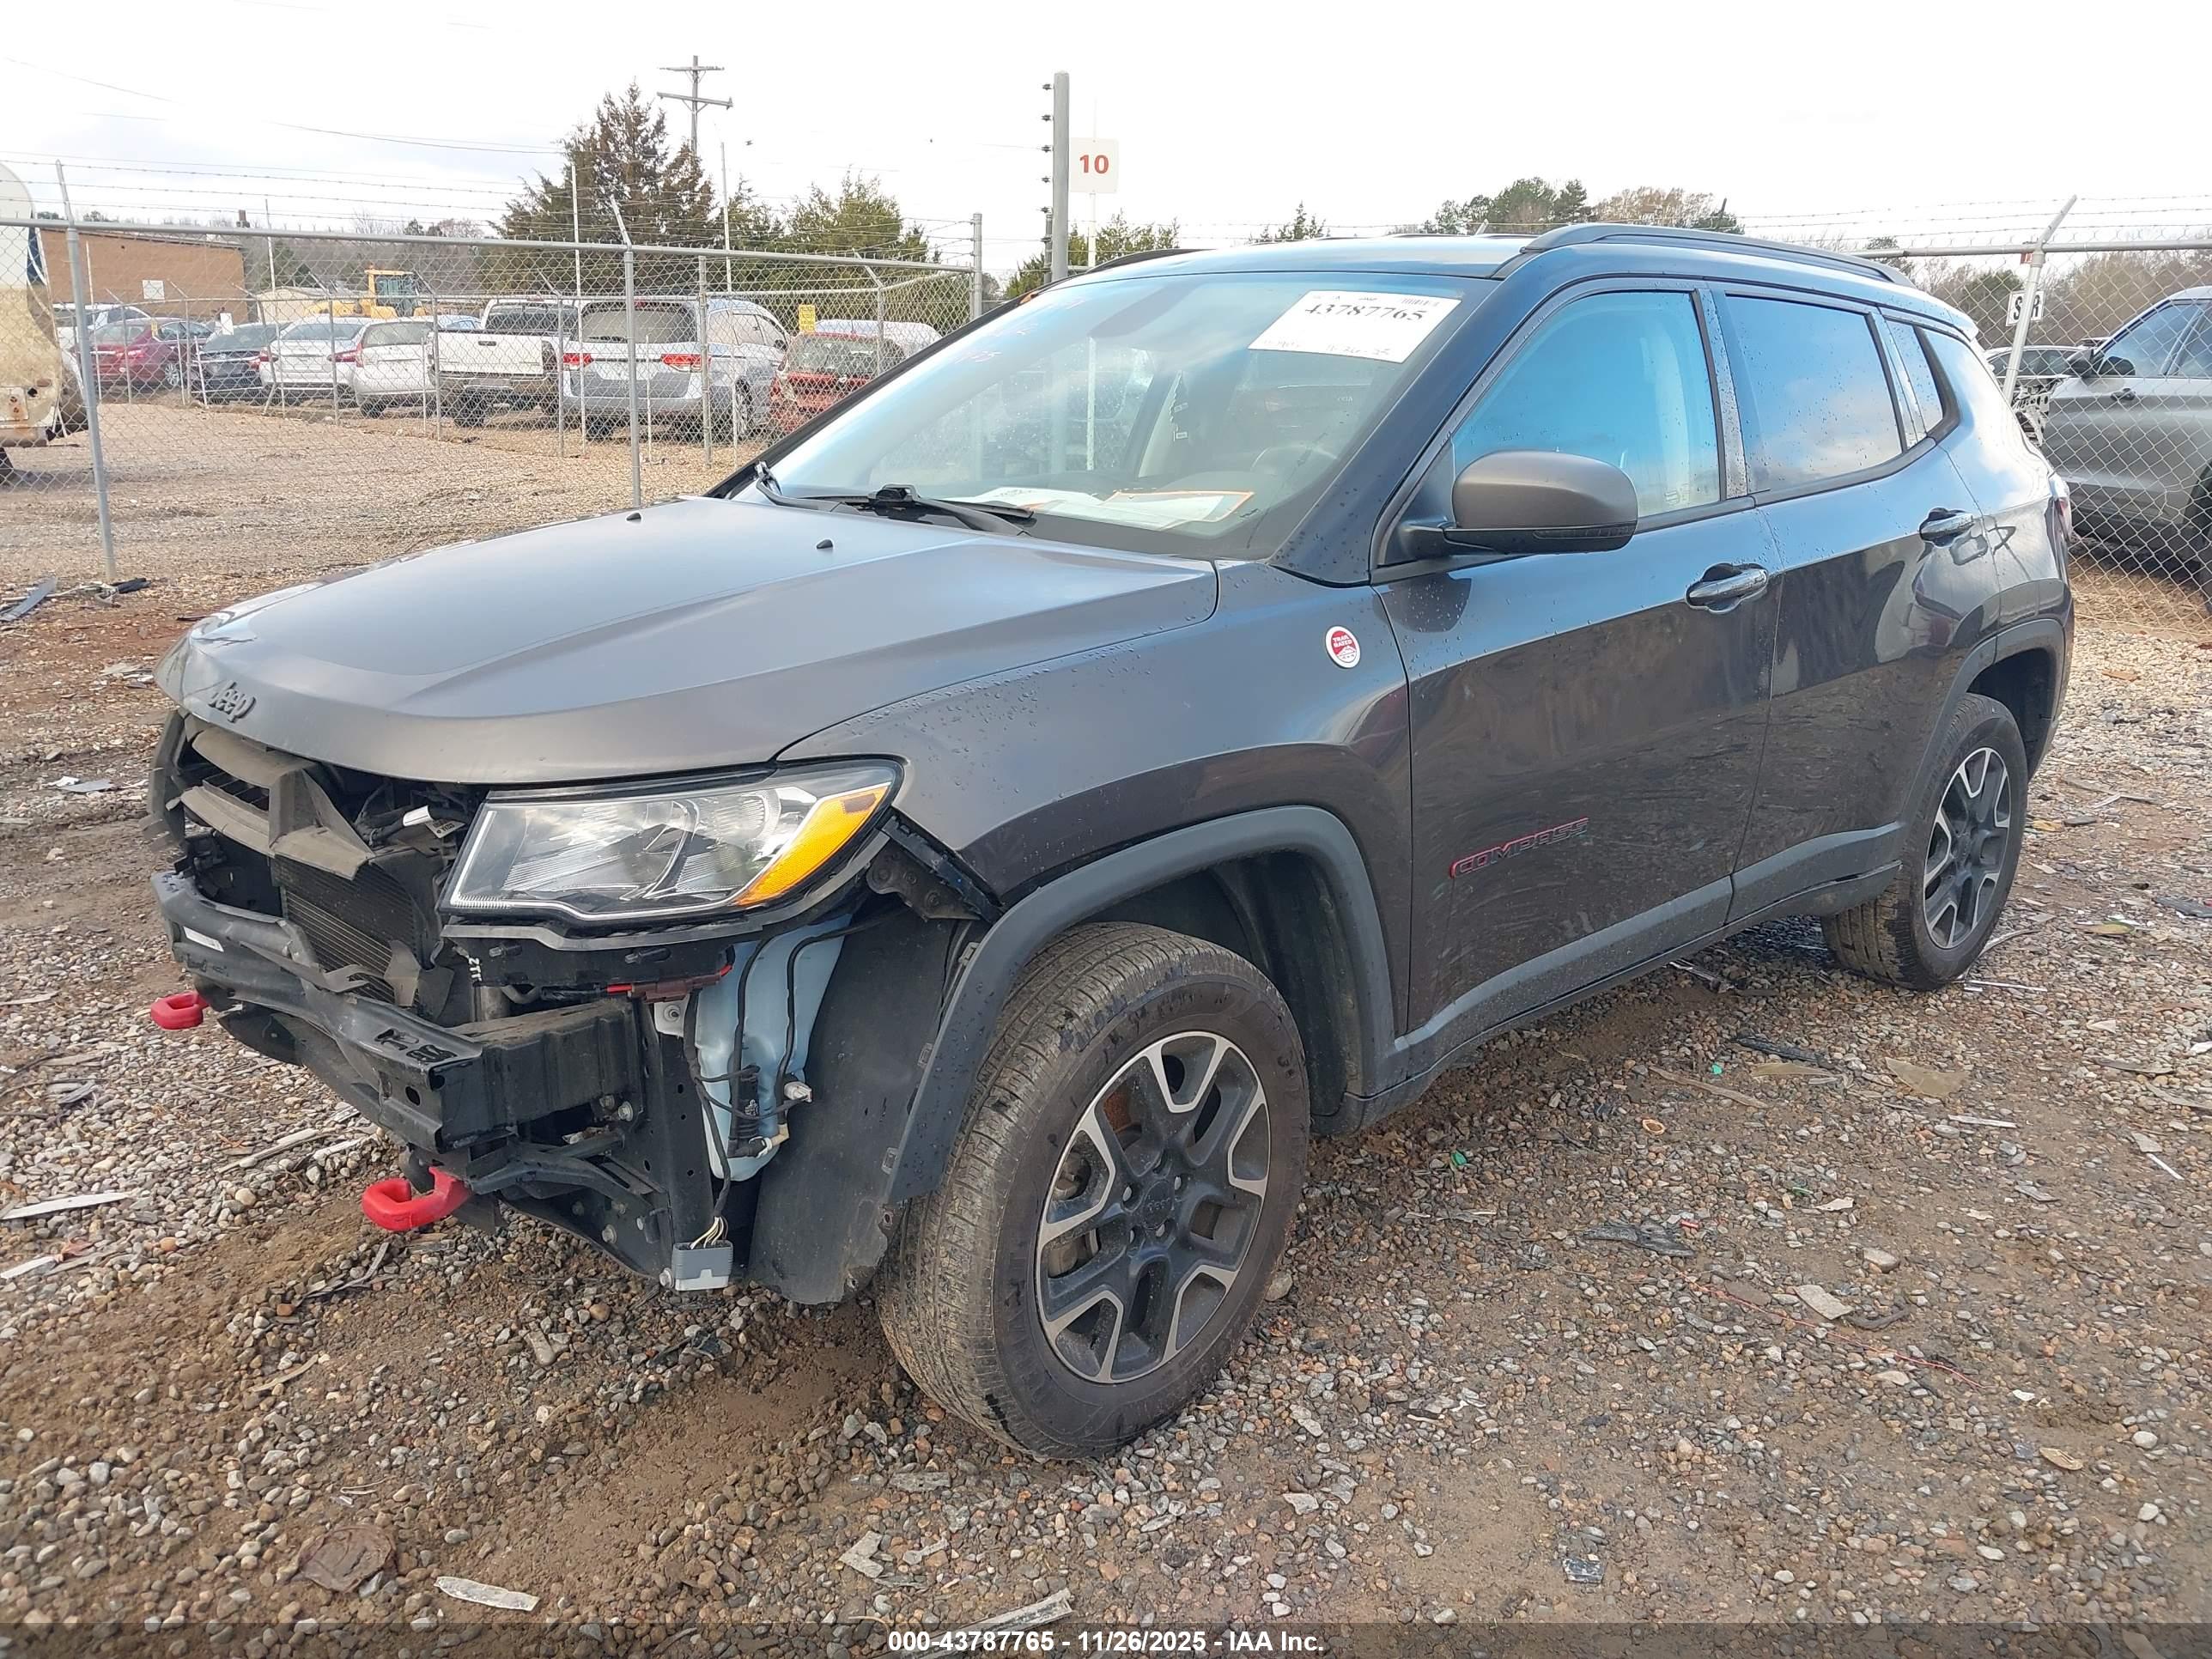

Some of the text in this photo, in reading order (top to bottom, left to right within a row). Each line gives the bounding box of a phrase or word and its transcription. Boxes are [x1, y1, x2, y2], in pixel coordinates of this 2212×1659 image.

[1079, 154, 1109, 174] 10
[1304, 302, 1428, 321] 43787765
[1333, 639, 1352, 648] RATED
[206, 680, 257, 723] Jeep
[1449, 817, 1589, 879] COMPASS
